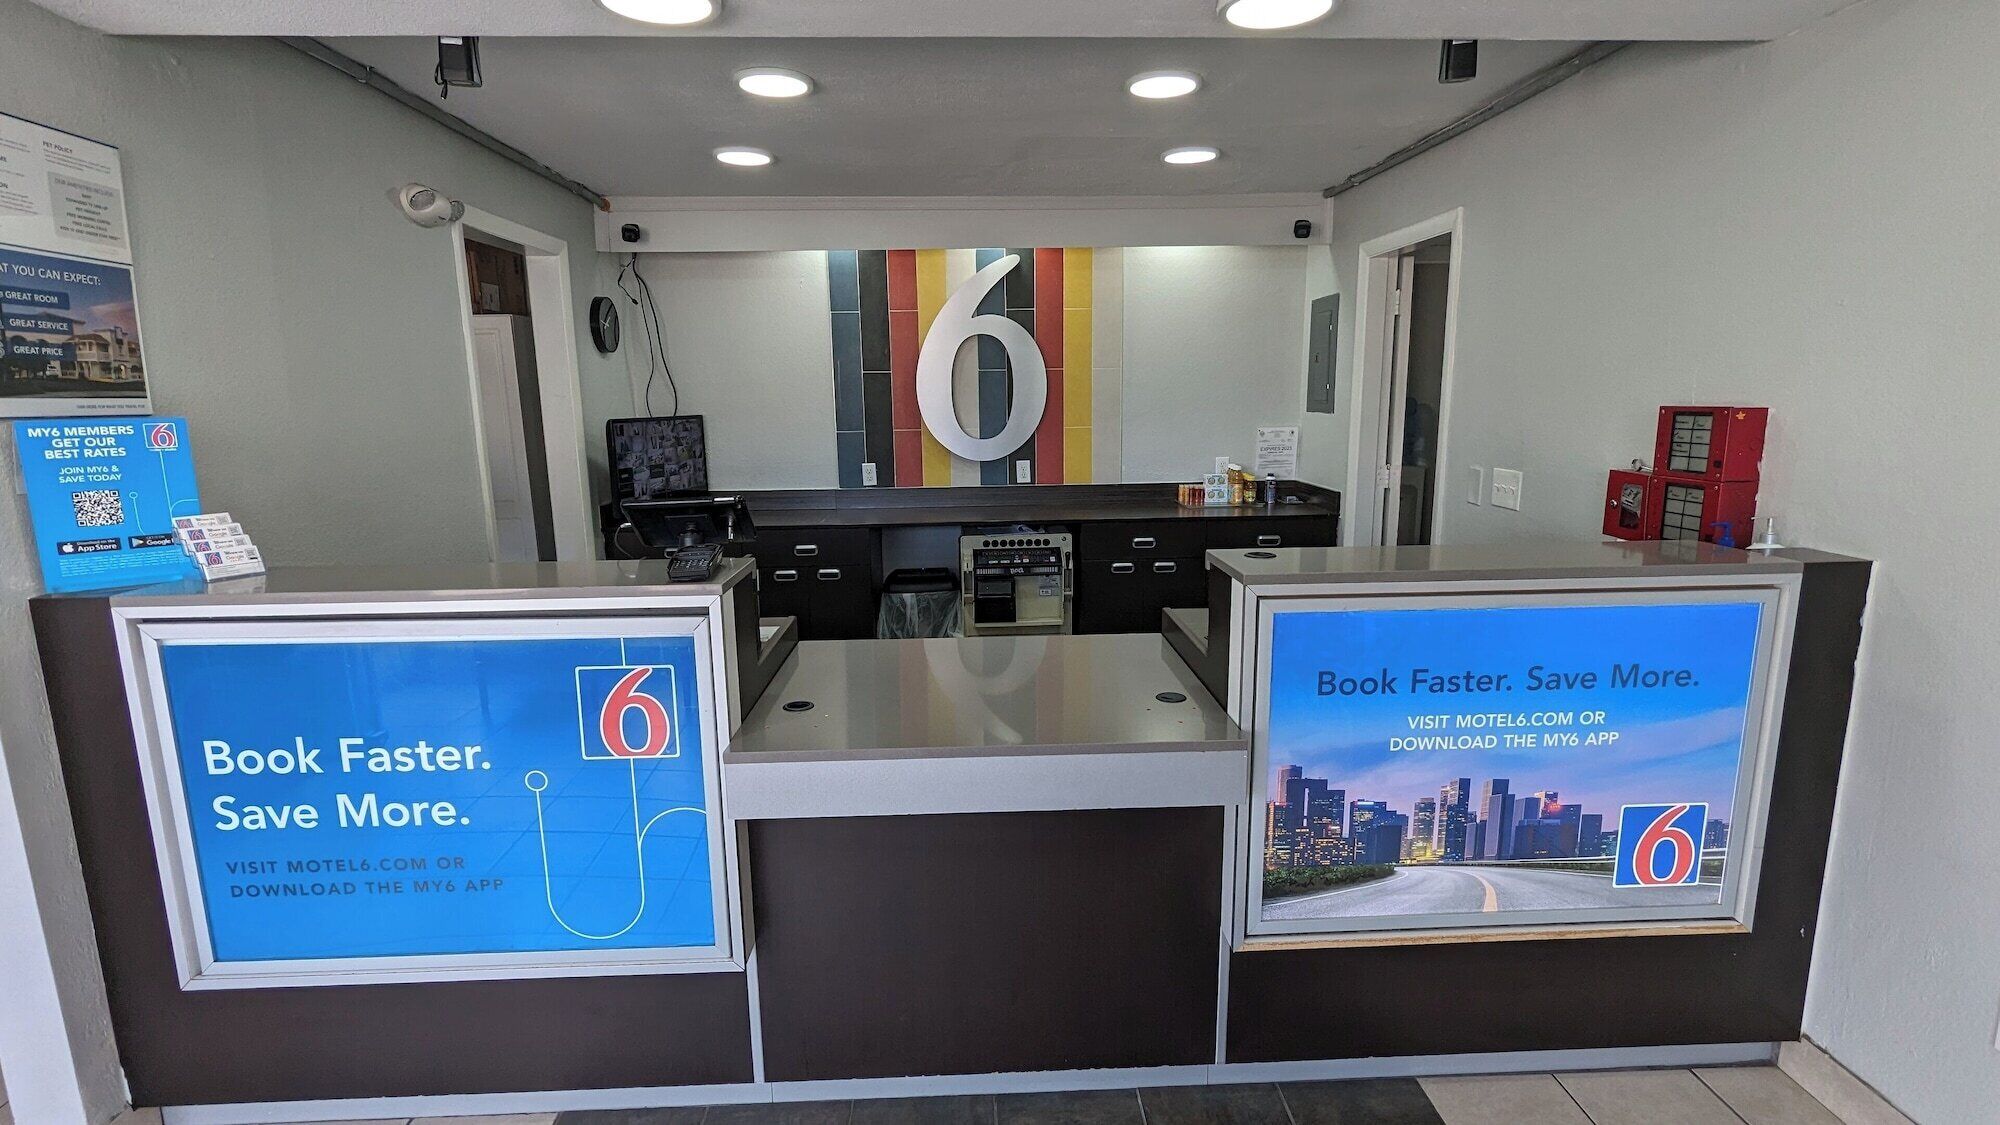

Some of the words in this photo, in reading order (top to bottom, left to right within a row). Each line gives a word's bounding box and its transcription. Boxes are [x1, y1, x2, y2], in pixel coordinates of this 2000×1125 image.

[12, 264, 35, 277] YOU
[38, 268, 61, 280] CAN
[63, 271, 102, 286] EXPECT:
[5, 290, 32, 301] GREAT
[34, 294, 59, 304] ROOM
[9, 318, 36, 328] GREAT
[38, 321, 69, 331] SERVICE
[13, 345, 40, 355] GREAT
[41, 347, 64, 356] PRICE
[916, 254, 1048, 462] 6
[27, 427, 60, 438] MY6
[64, 425, 135, 437] MEMBERS
[151, 423, 175, 448] 6
[52, 438, 80, 448] GET
[85, 437, 116, 447] OUR
[44, 449, 79, 460] BEST
[84, 447, 127, 458] RATES
[58, 475, 85, 484] SAVE
[88, 473, 122, 483] TODAY
[59, 466, 85, 475] JOIN
[87, 466, 109, 474] MY6
[111, 464, 119, 473] &
[77, 544, 95, 553] App
[95, 542, 117, 551] Store
[146, 539, 171, 547] Google
[1316, 667, 1399, 697] Book
[1410, 667, 1514, 694] Faster.
[1526, 664, 1598, 692] Save
[1610, 662, 1700, 689] More.
[600, 667, 671, 757] 6
[1408, 715, 1451, 730] VISIT
[1455, 711, 1573, 729] MOTEL6.COM
[1579, 711, 1606, 726] OR
[1389, 735, 1498, 752] DOWNLOAD
[1504, 734, 1538, 748] THE
[1543, 733, 1579, 748] MY6
[1586, 731, 1620, 746] APP
[202, 736, 325, 775] Book
[338, 737, 492, 773] Faster.
[212, 795, 319, 831] Save
[335, 793, 471, 828] More.
[1632, 804, 1696, 886] 6
[226, 860, 278, 875] VISIT
[287, 858, 427, 874] MOTEL6.COM
[436, 856, 465, 871] OR
[230, 882, 357, 898] DOWNLOAD
[365, 881, 403, 894] THE
[413, 880, 456, 893] MY6
[465, 878, 504, 892] APP
